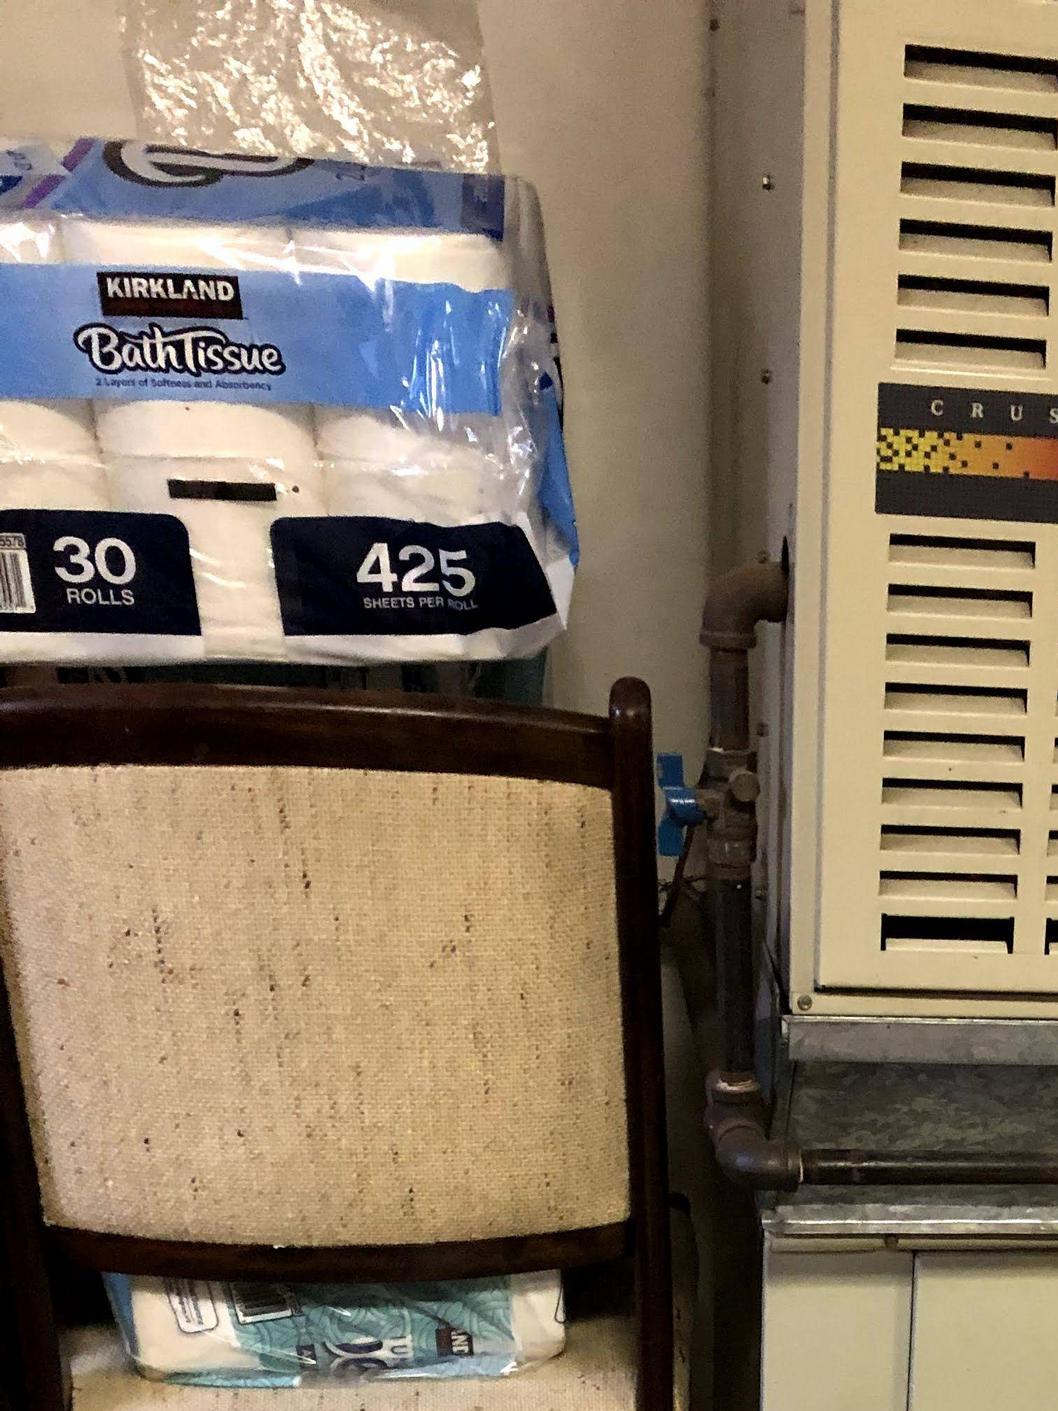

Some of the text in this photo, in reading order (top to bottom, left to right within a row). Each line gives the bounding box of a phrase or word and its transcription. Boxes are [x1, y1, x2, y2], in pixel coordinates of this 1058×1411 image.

[106, 277, 235, 301] KIRKLAND
[138, 378, 148, 387] of
[150, 379, 192, 389] Softness
[194, 380, 213, 388] and
[215, 380, 272, 392] Absorbency
[53, 536, 137, 585] 30
[356, 542, 476, 597] 425
[66, 588, 136, 606] ROLLS
[363, 596, 479, 611] SHEETS PER ROLL
